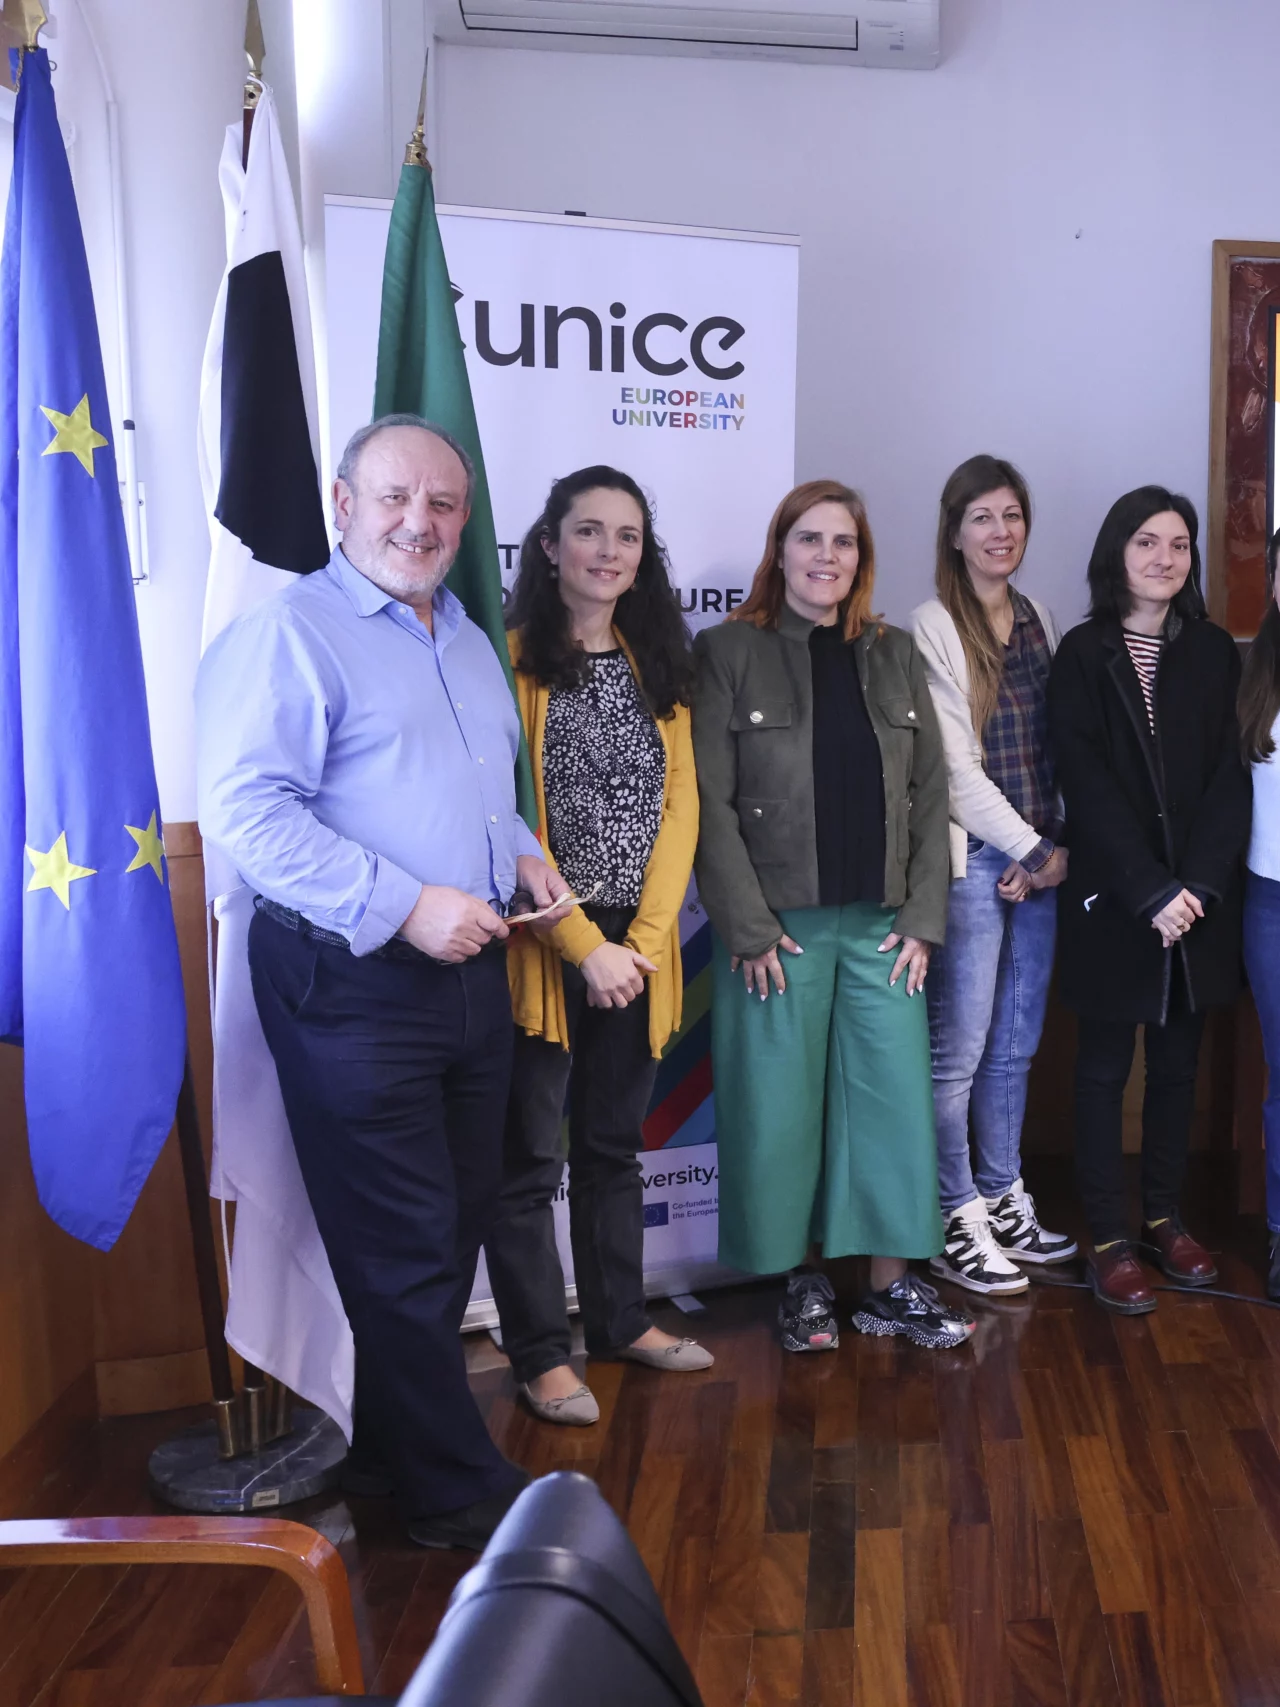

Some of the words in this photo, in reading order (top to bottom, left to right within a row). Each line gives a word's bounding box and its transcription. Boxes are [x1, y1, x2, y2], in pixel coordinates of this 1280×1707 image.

[449, 281, 746, 381] unice
[621, 387, 745, 410] EUROPEAN
[612, 409, 745, 431] UNIVERSITY
[675, 588, 744, 613] URE
[641, 1164, 719, 1190] versity.
[672, 1198, 713, 1210] Co-funded
[687, 1208, 719, 1218] Europea
